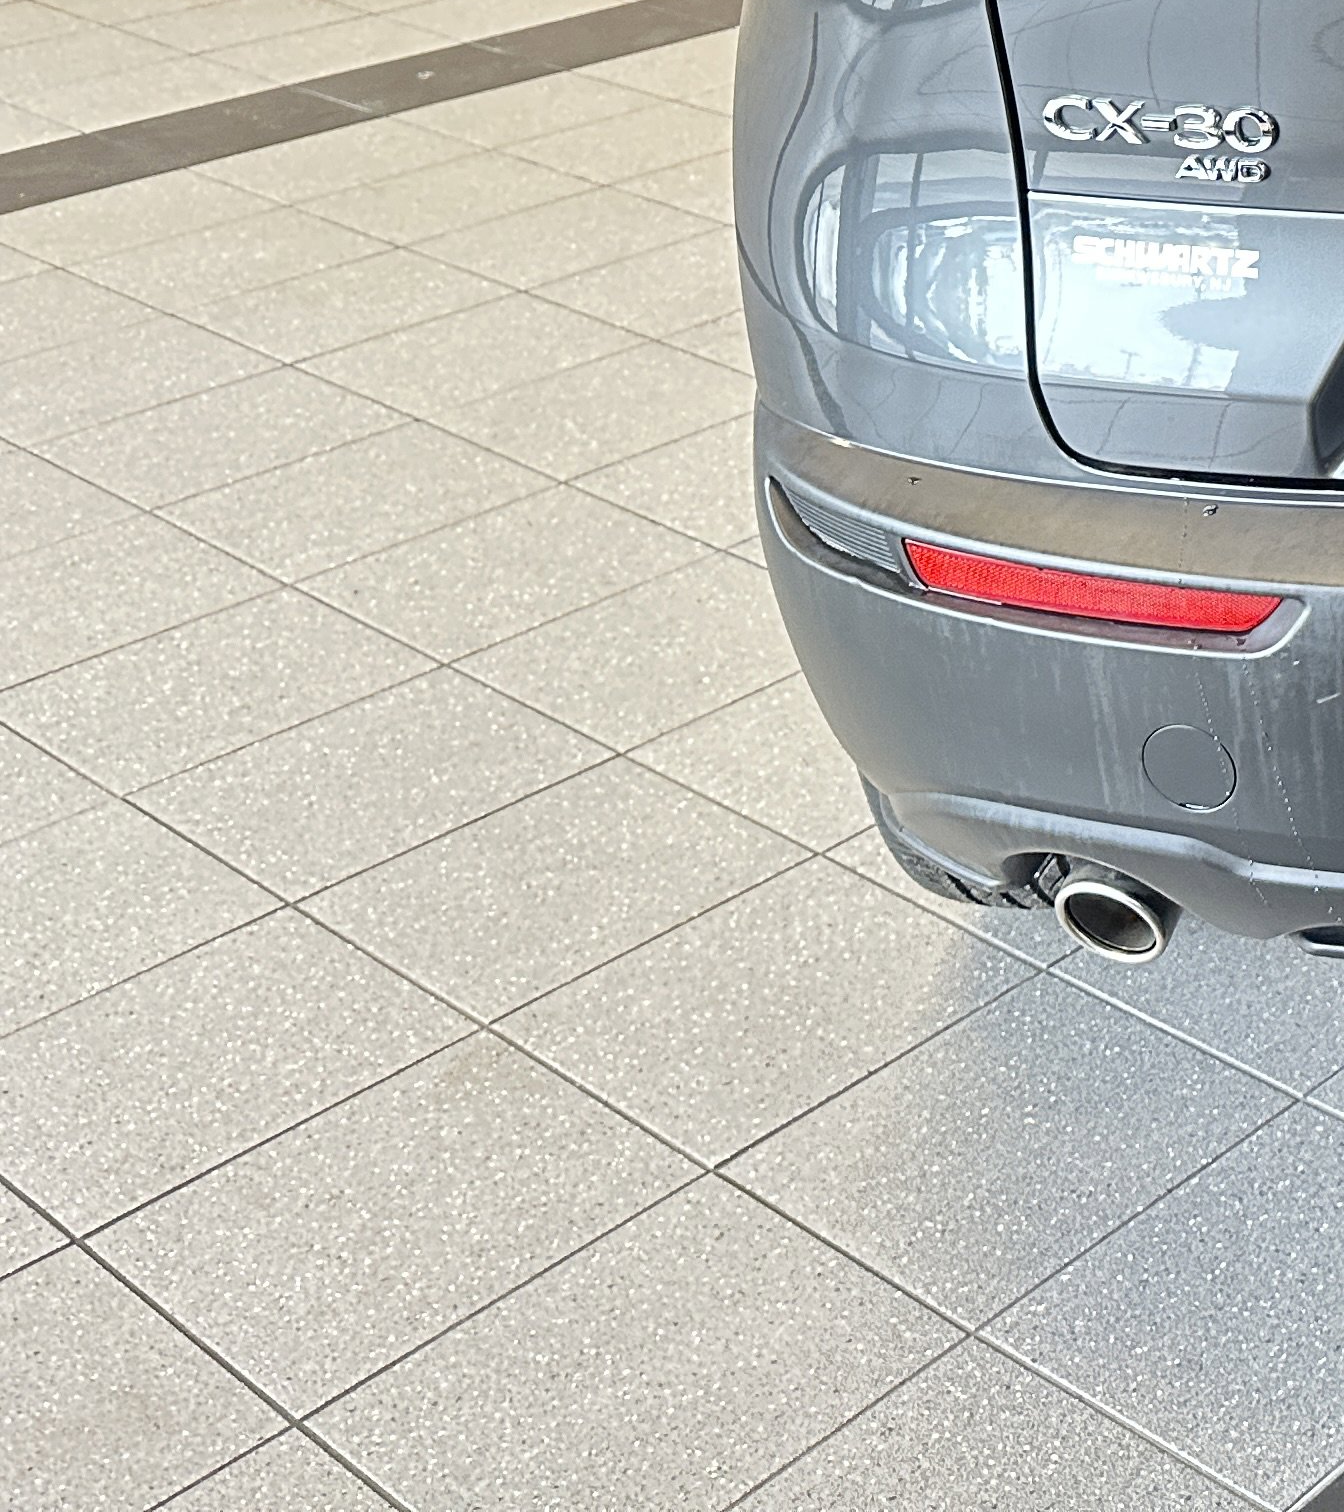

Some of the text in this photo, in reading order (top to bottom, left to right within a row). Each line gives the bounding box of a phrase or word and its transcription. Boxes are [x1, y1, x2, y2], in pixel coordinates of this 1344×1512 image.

[1042, 93, 1281, 154] CX-30
[1174, 153, 1271, 183] AWD
[1070, 235, 1260, 280] SCHWARTZ
